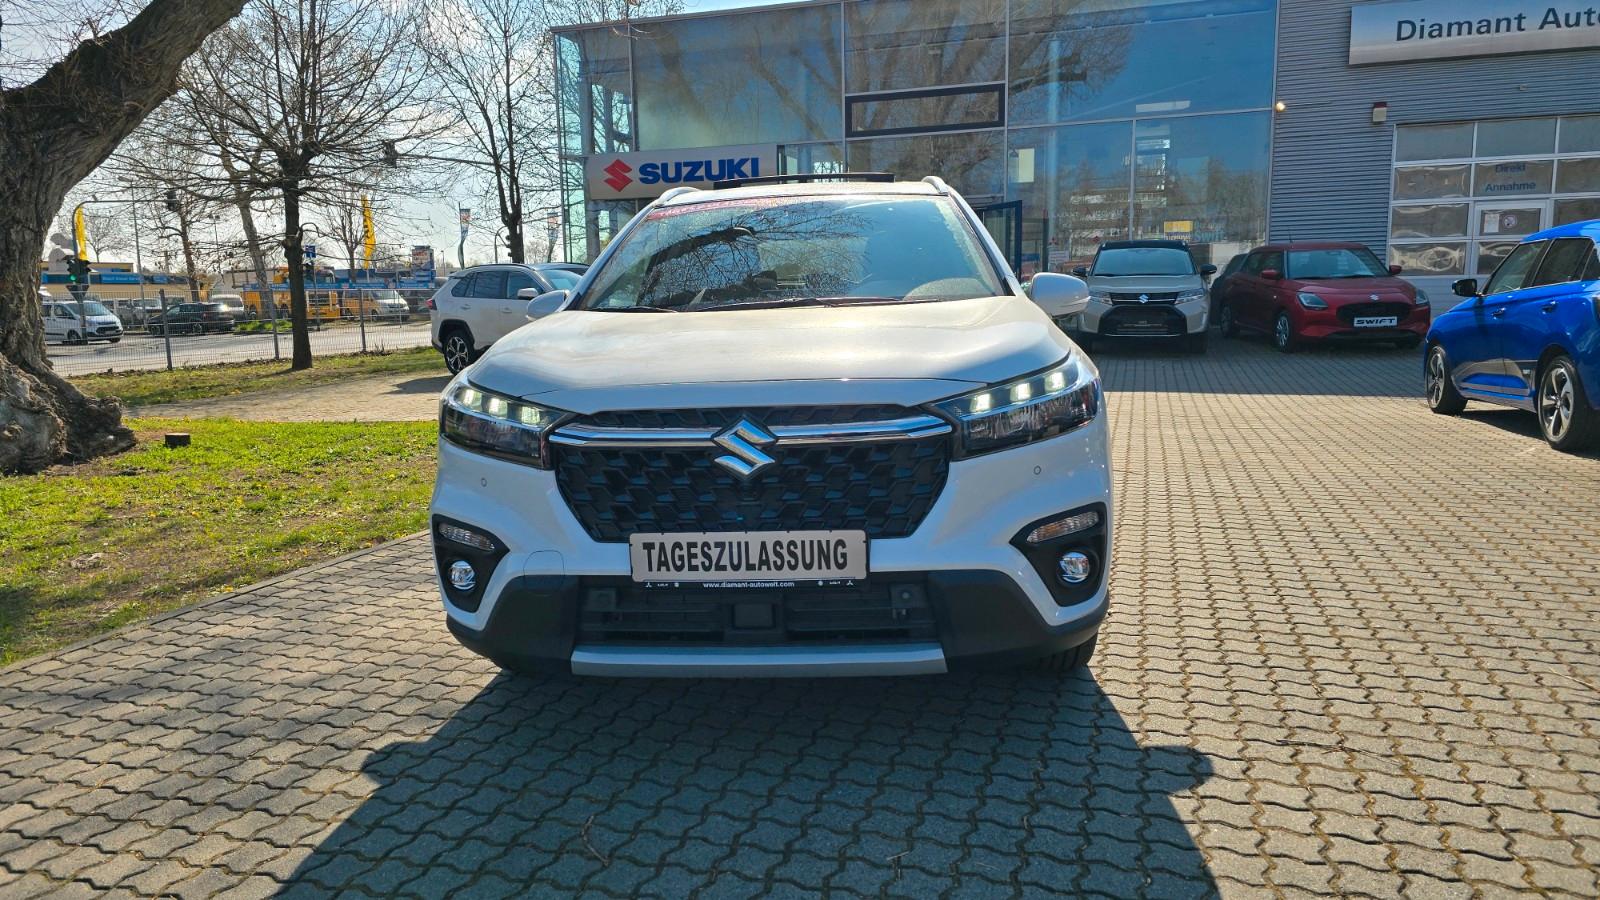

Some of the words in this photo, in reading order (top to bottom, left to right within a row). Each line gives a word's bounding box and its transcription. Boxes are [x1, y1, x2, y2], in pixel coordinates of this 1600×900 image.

[1396, 12, 1526, 42] Diamant
[1538, 7, 1600, 30] Aut
[639, 158, 758, 184] SUZUKI
[1485, 181, 1536, 192] Annahme
[642, 539, 847, 571] TAGESZULASSUNG
